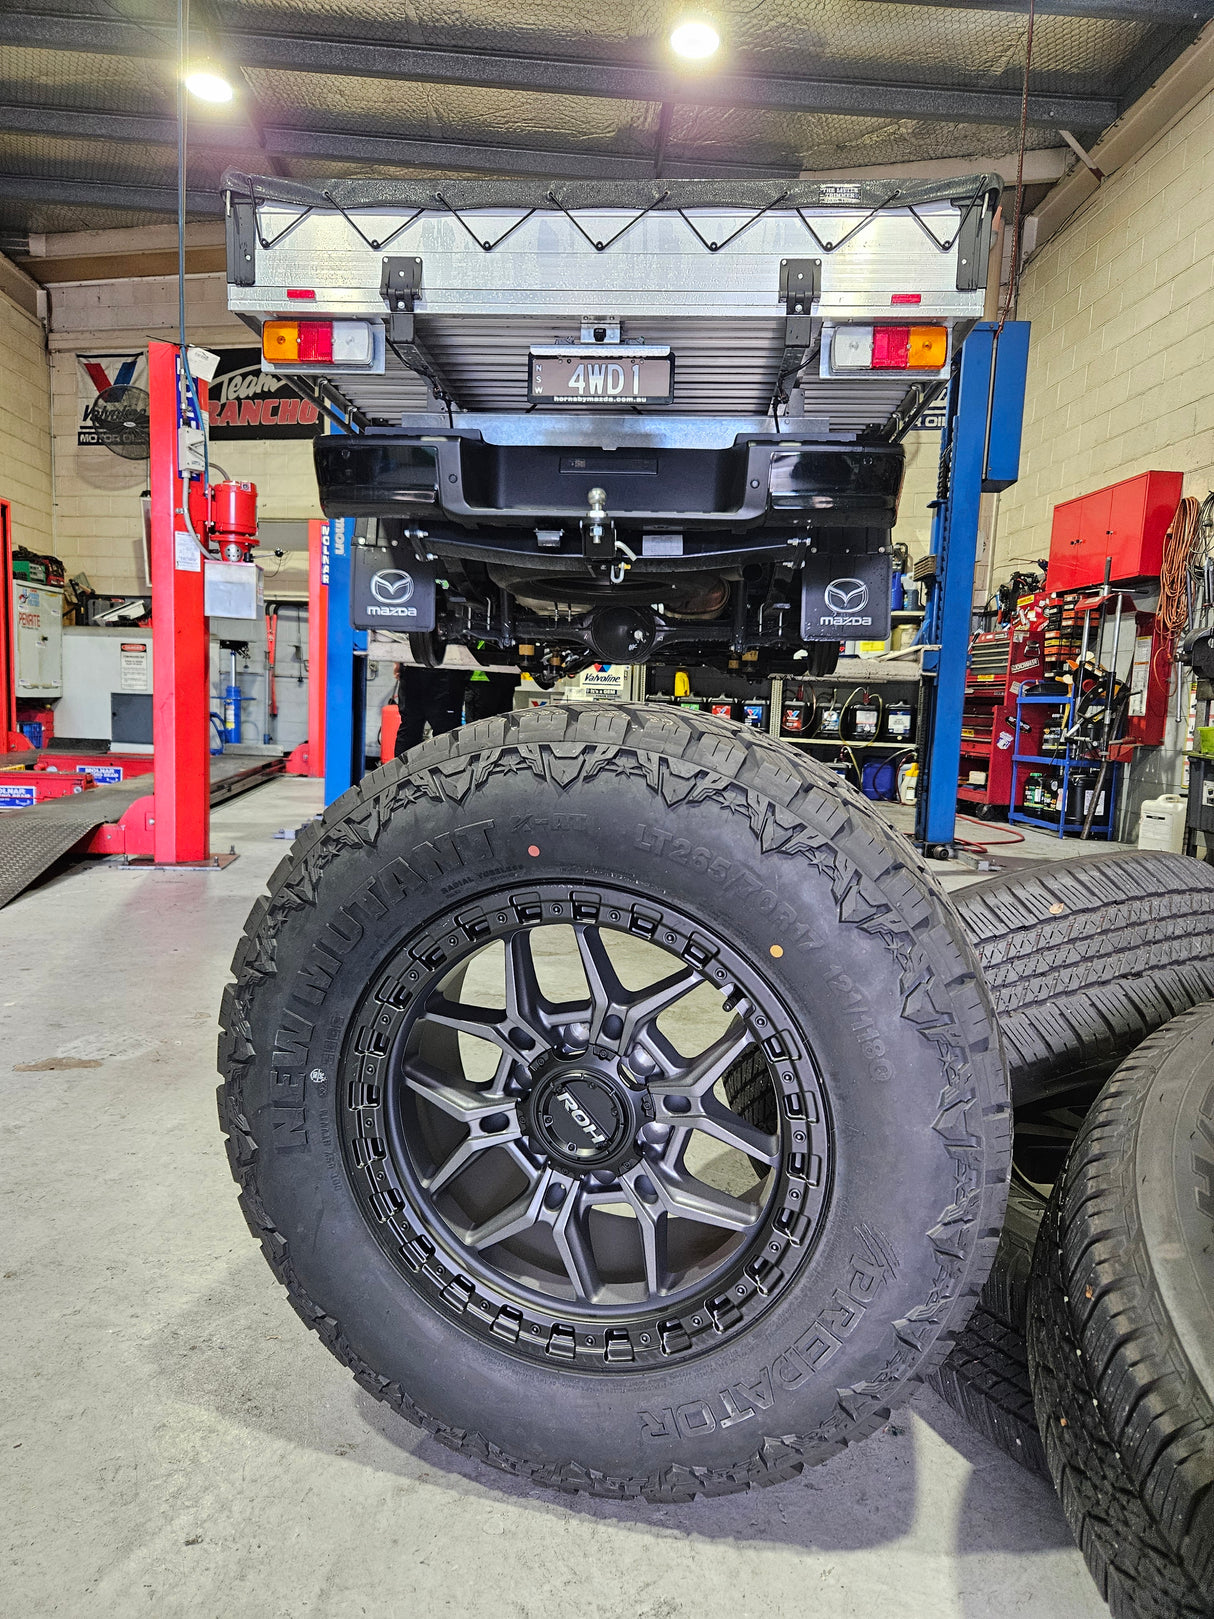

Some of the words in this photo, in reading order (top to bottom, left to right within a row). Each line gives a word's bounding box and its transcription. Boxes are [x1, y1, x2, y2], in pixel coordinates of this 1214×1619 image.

[211, 364, 287, 405] Team
[554, 395, 647, 403] hornsbymazda.com.au
[208, 398, 319, 427] RANCHO
[366, 605, 418, 617] mazda
[820, 616, 872, 626] mazda
[584, 672, 621, 683] Valvoline
[557, 1091, 606, 1144] ROH
[637, 1251, 890, 1440] PREDATOR
